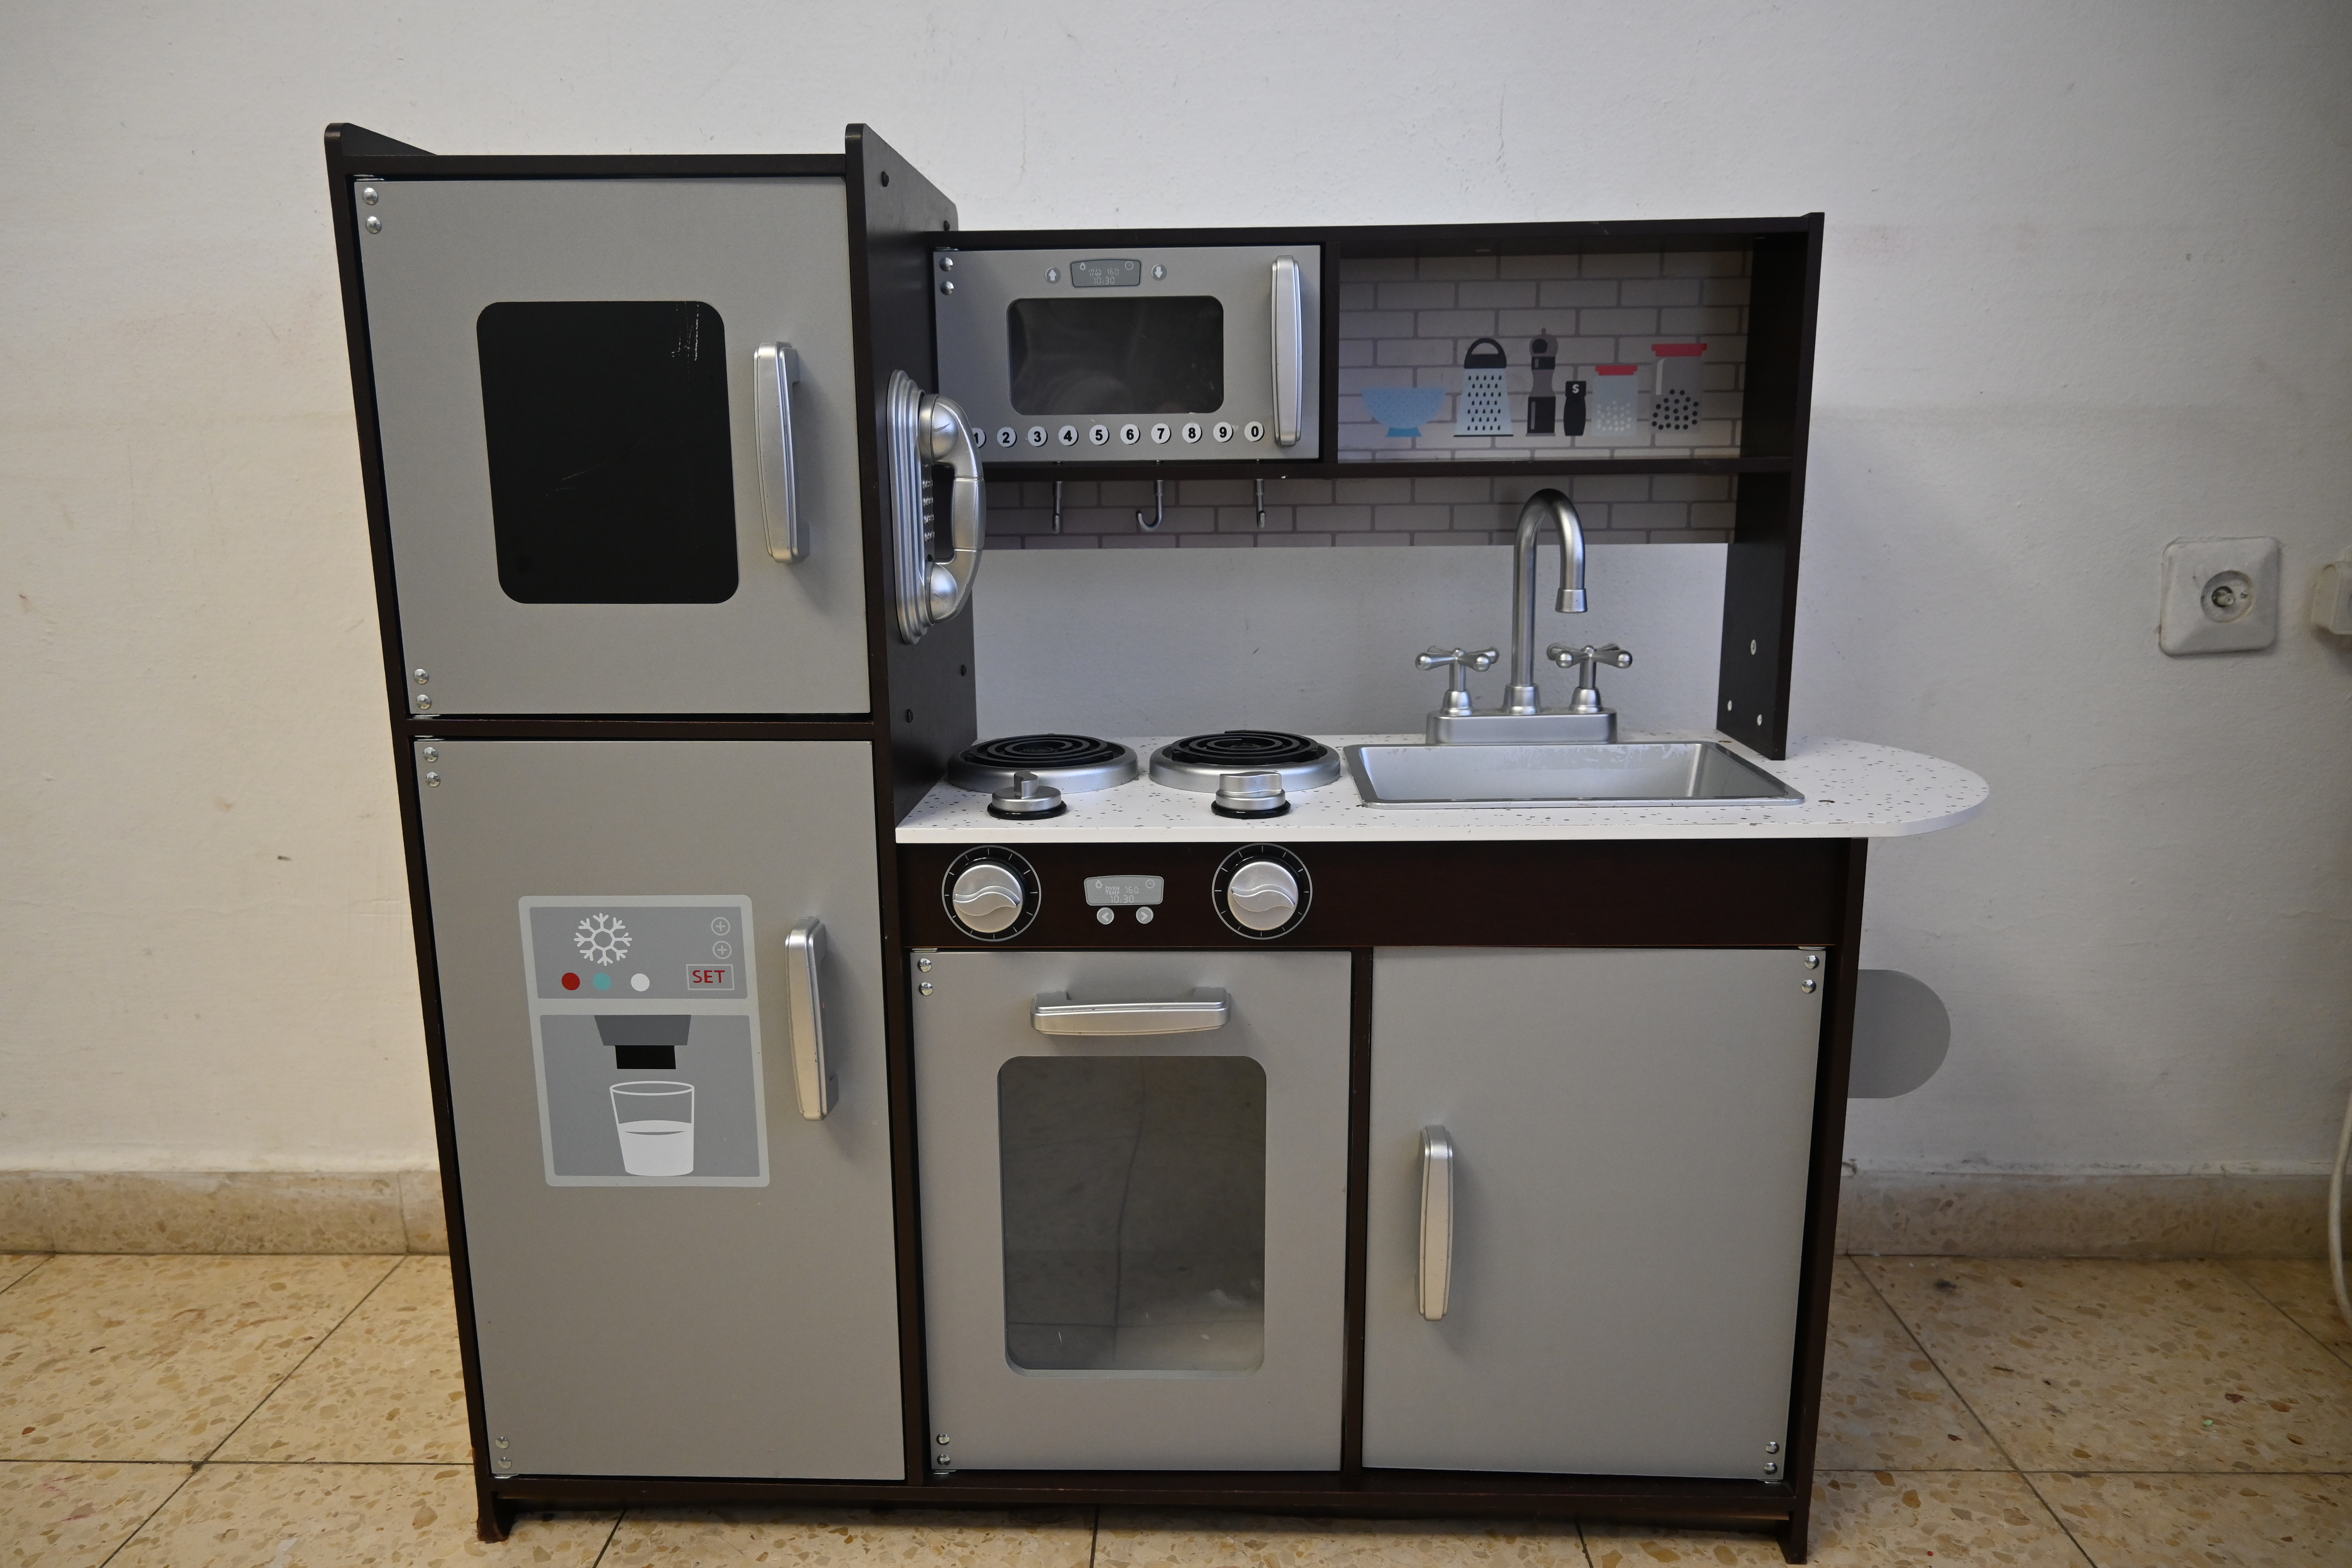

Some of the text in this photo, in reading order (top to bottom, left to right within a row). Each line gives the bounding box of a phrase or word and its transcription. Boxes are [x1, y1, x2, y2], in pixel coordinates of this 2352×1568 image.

[1572, 384, 1579, 394] S
[974, 426, 1259, 444] 1 2 3 4 5 6 7 8 9 0
[1110, 895, 1134, 903] 10:30
[692, 970, 726, 983] SET
